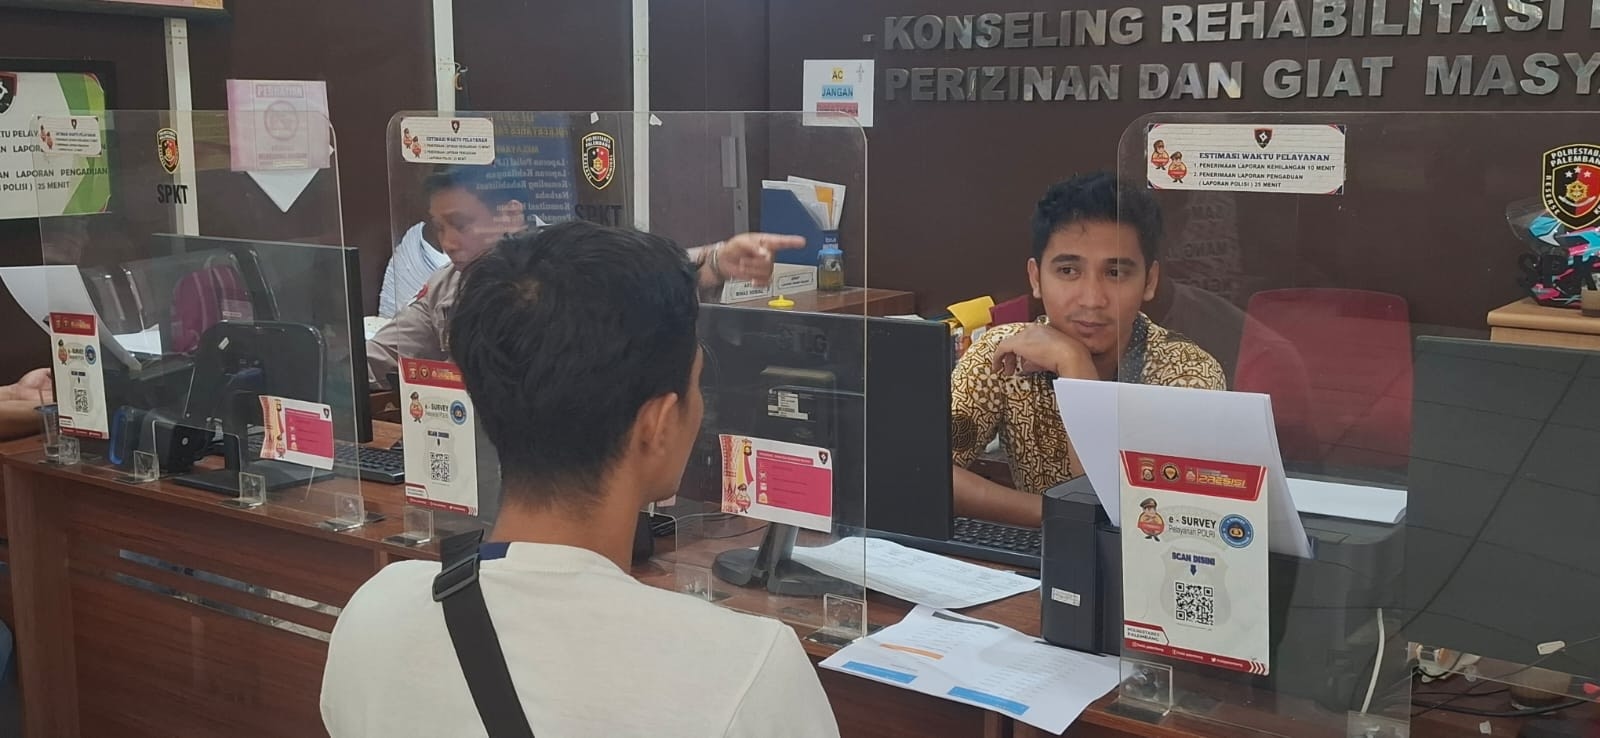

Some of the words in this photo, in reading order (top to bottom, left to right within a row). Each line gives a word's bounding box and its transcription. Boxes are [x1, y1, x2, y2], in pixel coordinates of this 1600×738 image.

[884, 7, 1144, 50] KONSELING
[1161, 0, 1565, 43] REHABILITASI
[832, 70, 844, 80] AC
[885, 64, 1122, 102] PERIZINAN
[1138, 61, 1243, 101] DAN
[1263, 56, 1393, 99] GIAT
[1425, 52, 1600, 97] MASY
[822, 88, 854, 97] JANGAN
[13, 130, 39, 138] PELAY
[13, 144, 44, 153] LAPOR
[1551, 147, 1600, 159] POLRESTAB
[1199, 152, 1240, 160] ESTIMASI
[1242, 152, 1274, 160] WAKTU
[1550, 156, 1600, 167] PALEMBAN
[16, 169, 54, 178] LAPORAN
[60, 167, 108, 176] PENGADUAN
[3, 183, 28, 191] POLISI
[47, 181, 70, 190] MENIT
[157, 184, 188, 204] SPKT
[1545, 175, 1560, 215] RESERSE
[1182, 516, 1216, 529] SURVEY
[1169, 525, 1196, 536] Pelayanan
[1172, 552, 1192, 562] SCAN
[1193, 556, 1216, 566] DISINI
